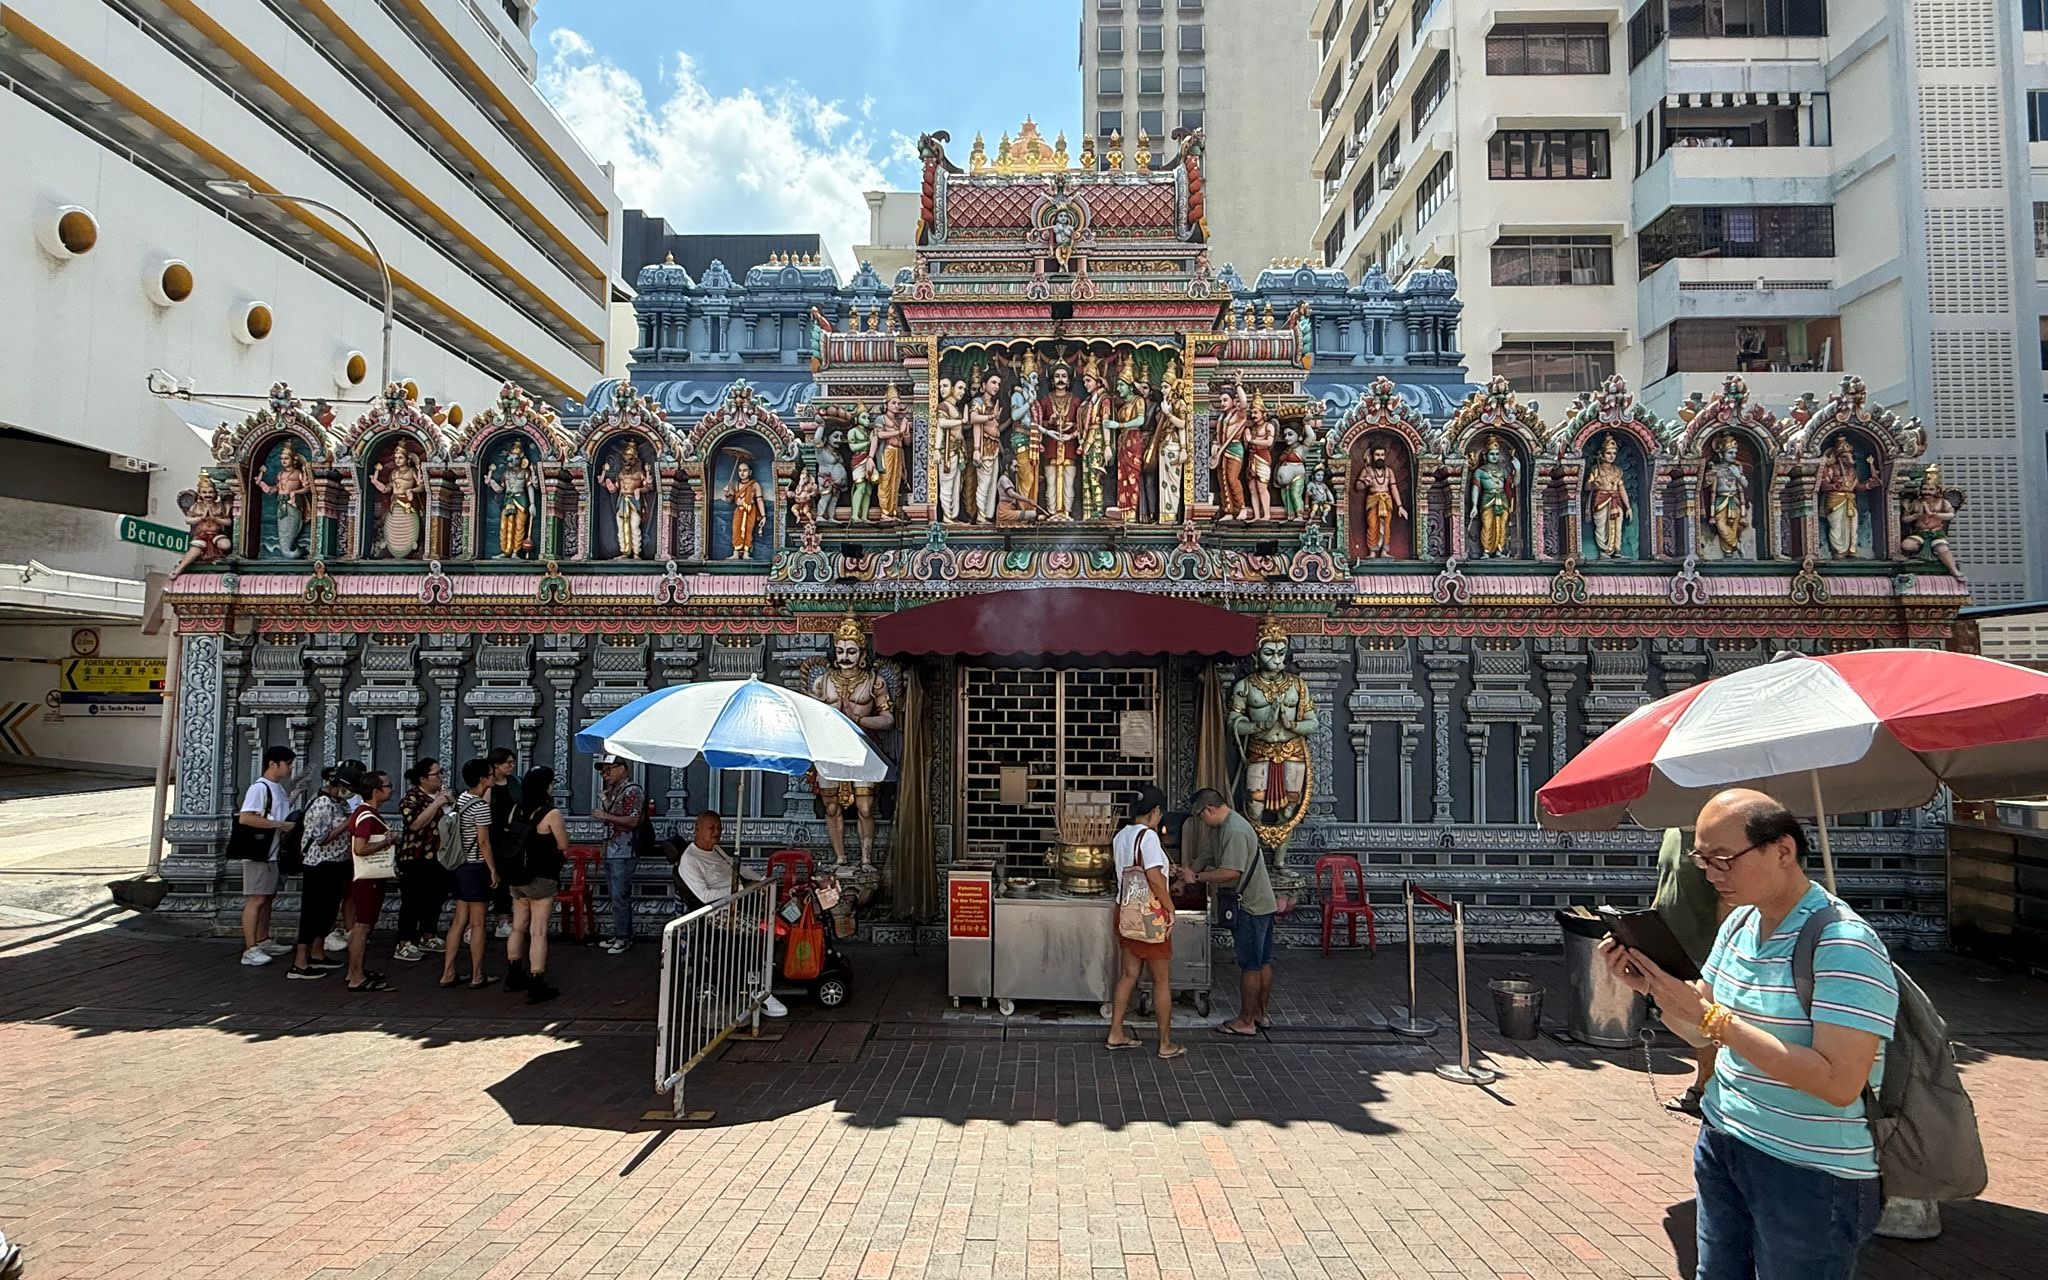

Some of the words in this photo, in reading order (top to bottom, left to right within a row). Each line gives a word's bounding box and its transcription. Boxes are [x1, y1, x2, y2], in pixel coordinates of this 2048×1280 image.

[127, 520, 189, 551] Bencool
[84, 659, 116, 667] FORTUNE
[117, 659, 142, 667] CENTRE
[144, 659, 167, 667] CARPA
